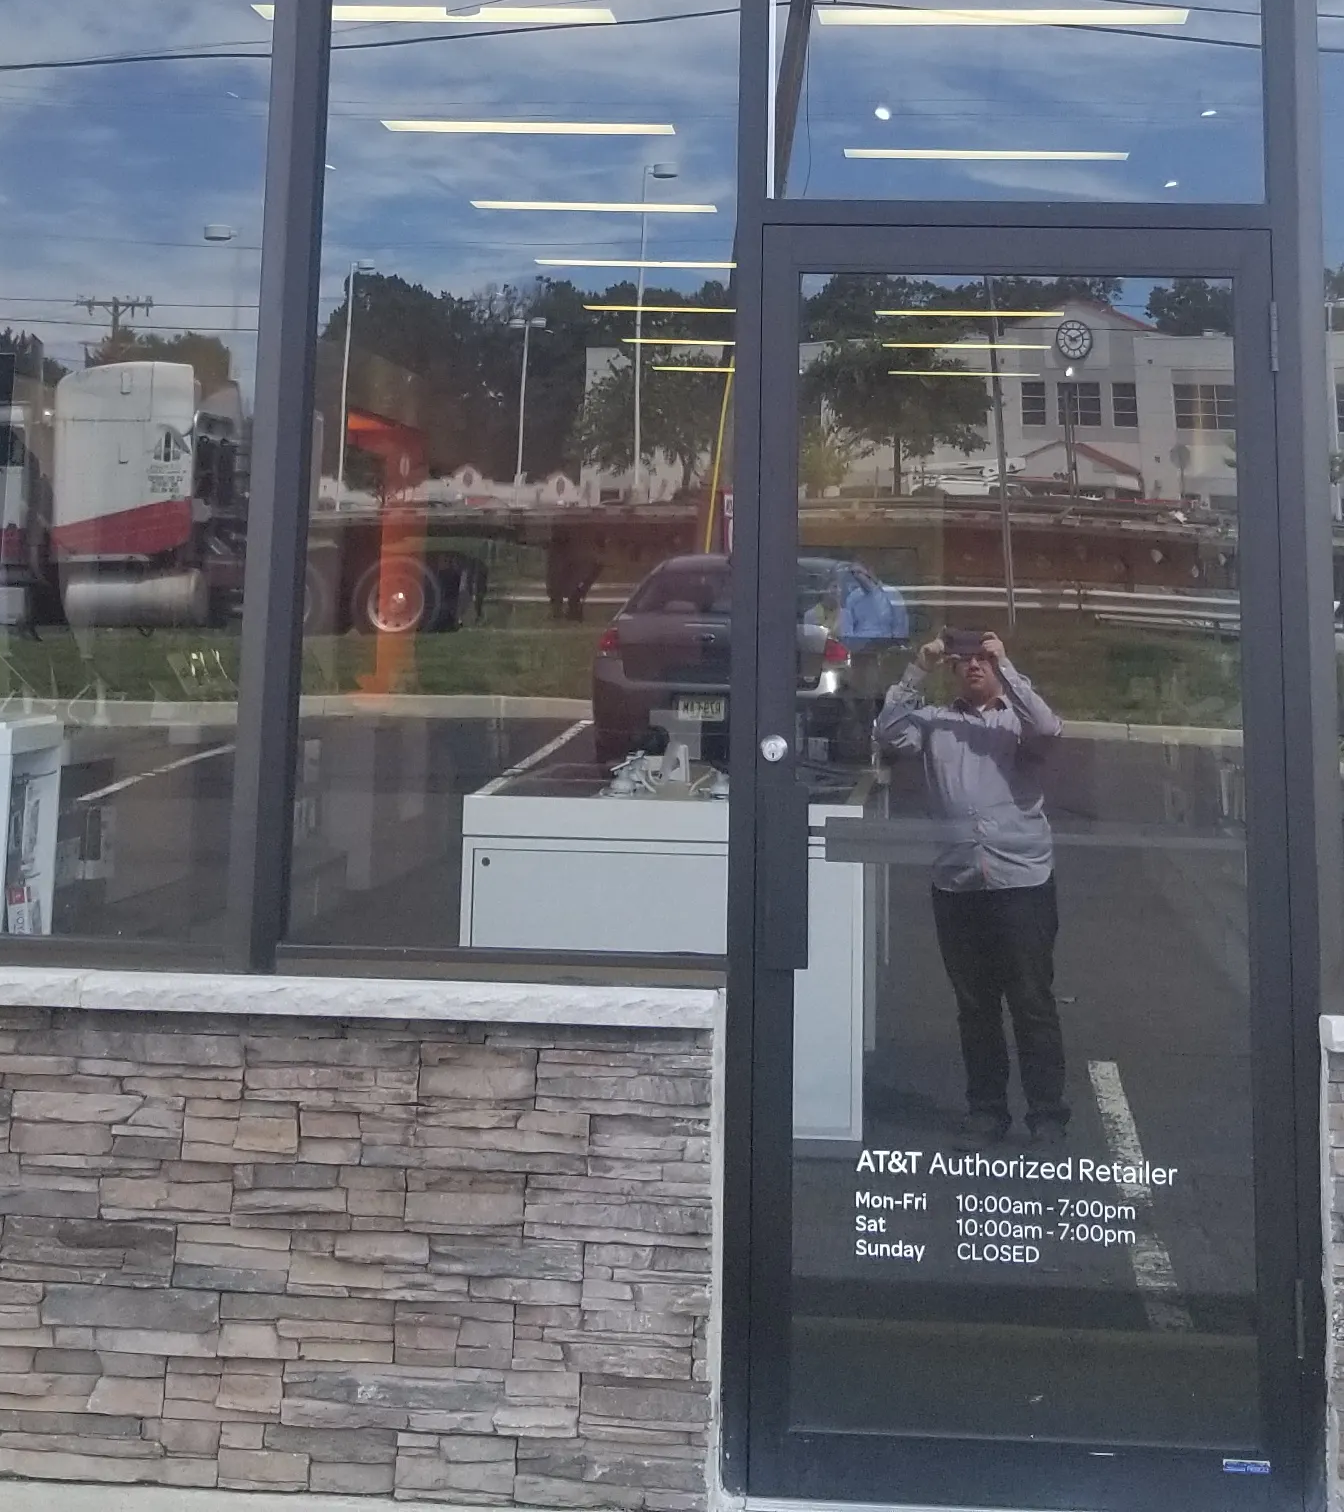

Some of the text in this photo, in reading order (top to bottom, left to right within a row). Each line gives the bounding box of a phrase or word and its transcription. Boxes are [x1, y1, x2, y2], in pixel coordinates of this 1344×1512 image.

[856, 1149, 1179, 1186] AT&T Authorized Retailer
[855, 1191, 928, 1211] Mon-Fri
[956, 1194, 1043, 1216] 10:00am
[1057, 1199, 1137, 1223] 7:00pm
[855, 1215, 887, 1233] Sat
[956, 1218, 1043, 1240] 10:00am
[1057, 1223, 1137, 1247] 7:00pm
[855, 1239, 1041, 1263] Sunday CLOSED
